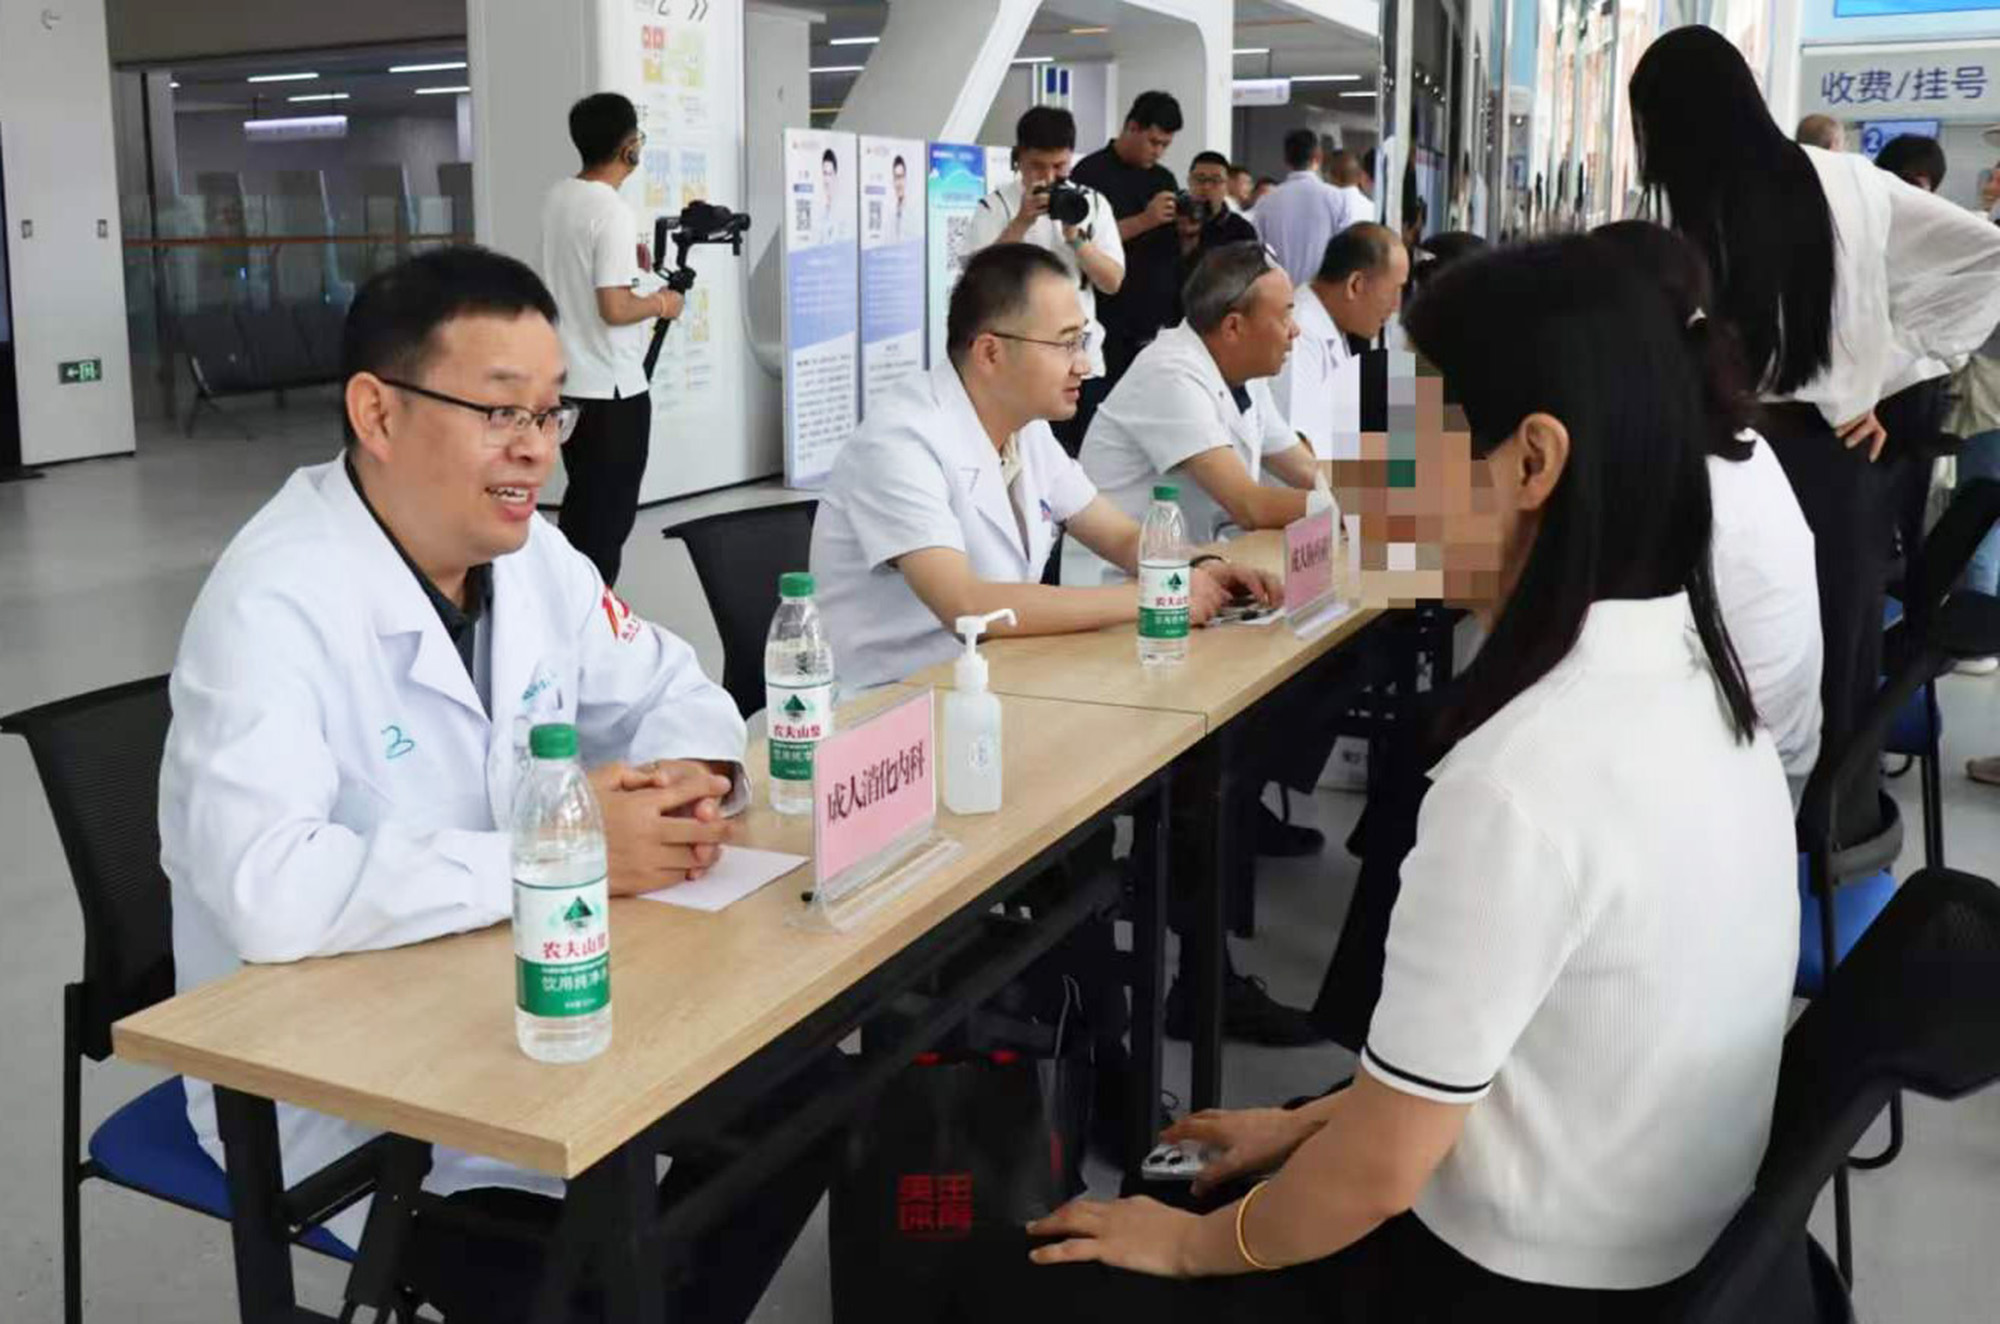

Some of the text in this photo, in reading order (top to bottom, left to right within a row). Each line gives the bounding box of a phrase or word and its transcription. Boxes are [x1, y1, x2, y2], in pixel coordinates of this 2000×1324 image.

[1821, 66, 1988, 104] 收费/挂号
[827, 741, 926, 823] 成人消化内科
